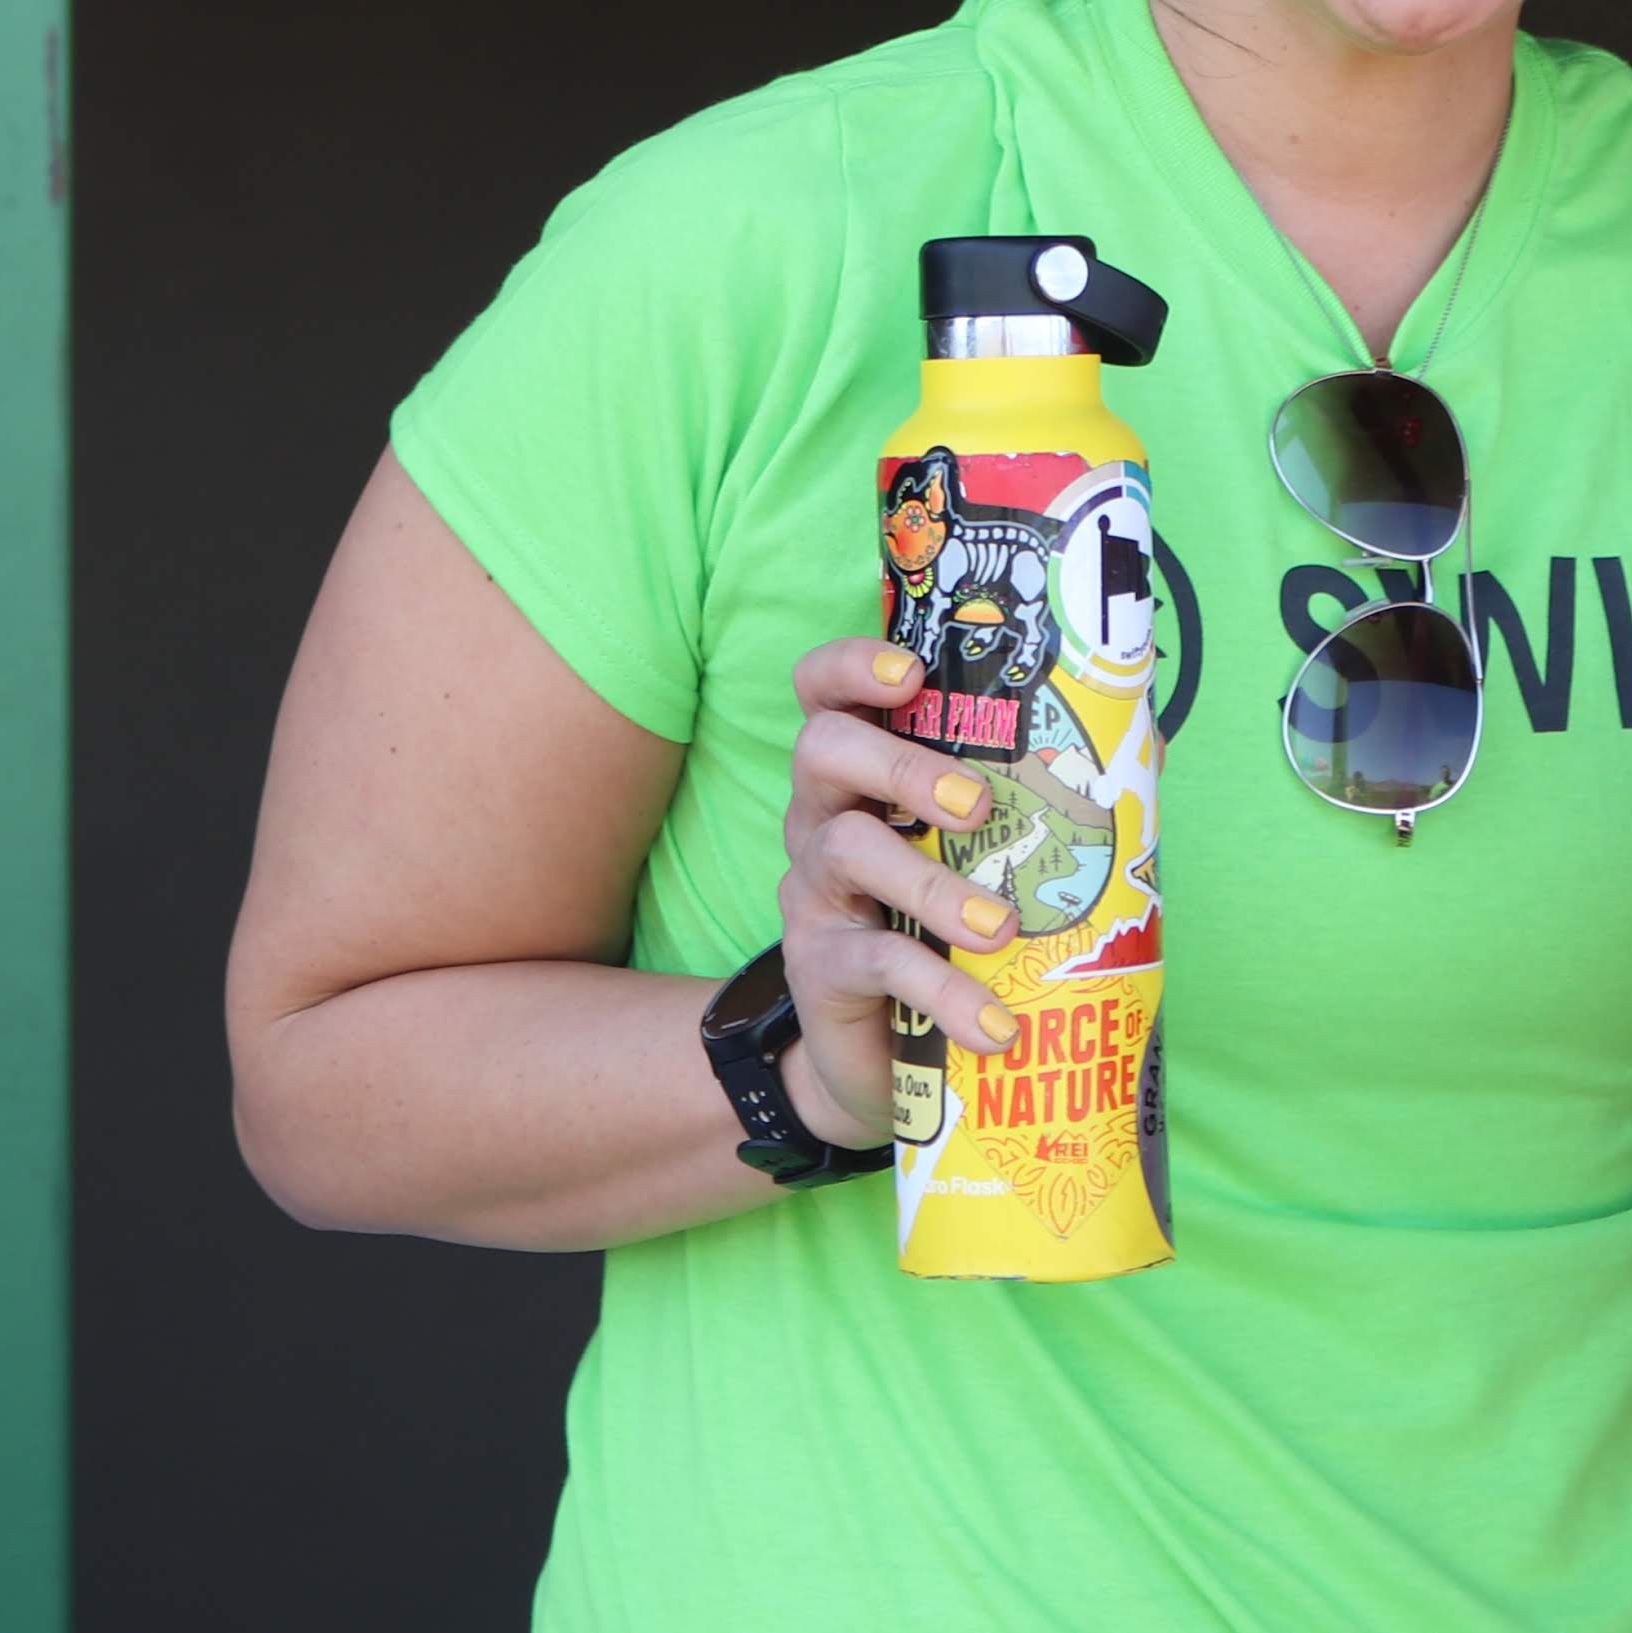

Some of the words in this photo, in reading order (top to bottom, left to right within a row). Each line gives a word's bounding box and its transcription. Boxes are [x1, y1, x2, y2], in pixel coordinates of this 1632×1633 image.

[944, 691, 1021, 750] FARM
[948, 824, 1011, 871] WILD
[1125, 1009, 1142, 1040] OF
[977, 1054, 1137, 1129] NATURE
[1054, 1142, 1088, 1158] REI
[951, 1176, 1004, 1196] Flask
